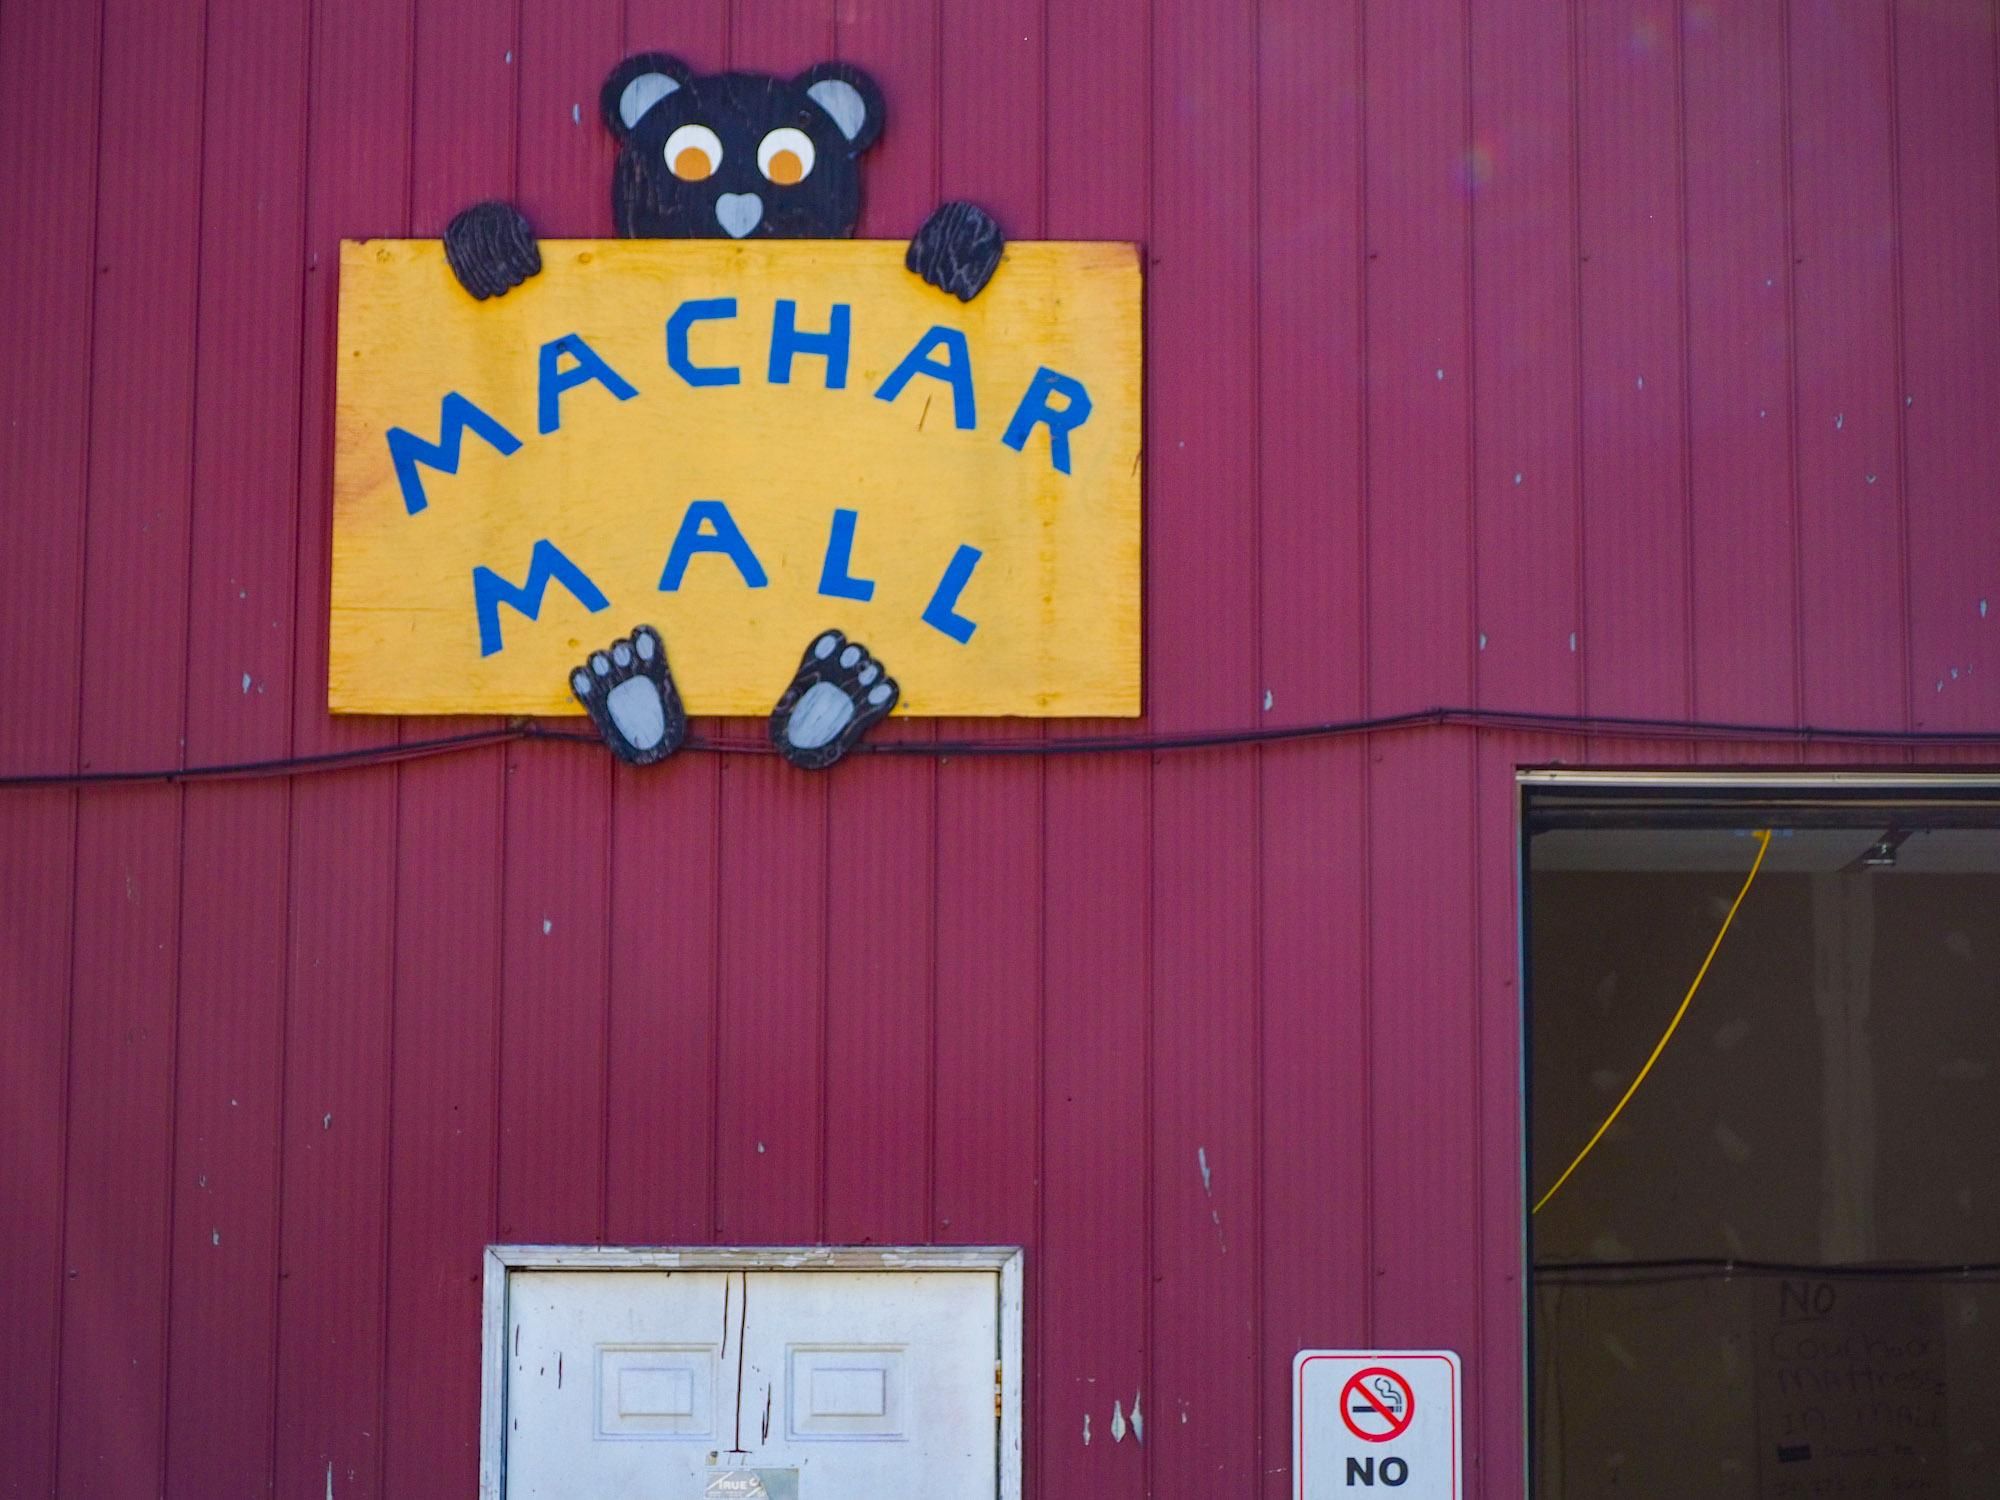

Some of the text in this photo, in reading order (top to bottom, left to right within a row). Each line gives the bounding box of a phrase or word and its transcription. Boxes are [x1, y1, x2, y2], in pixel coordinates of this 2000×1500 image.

[386, 297, 1093, 516] MACHAR
[471, 500, 983, 657] MALL
[1780, 1280, 1836, 1317] NO
[718, 1479, 748, 1490] TRUE
[1346, 1456, 1409, 1487] NO
